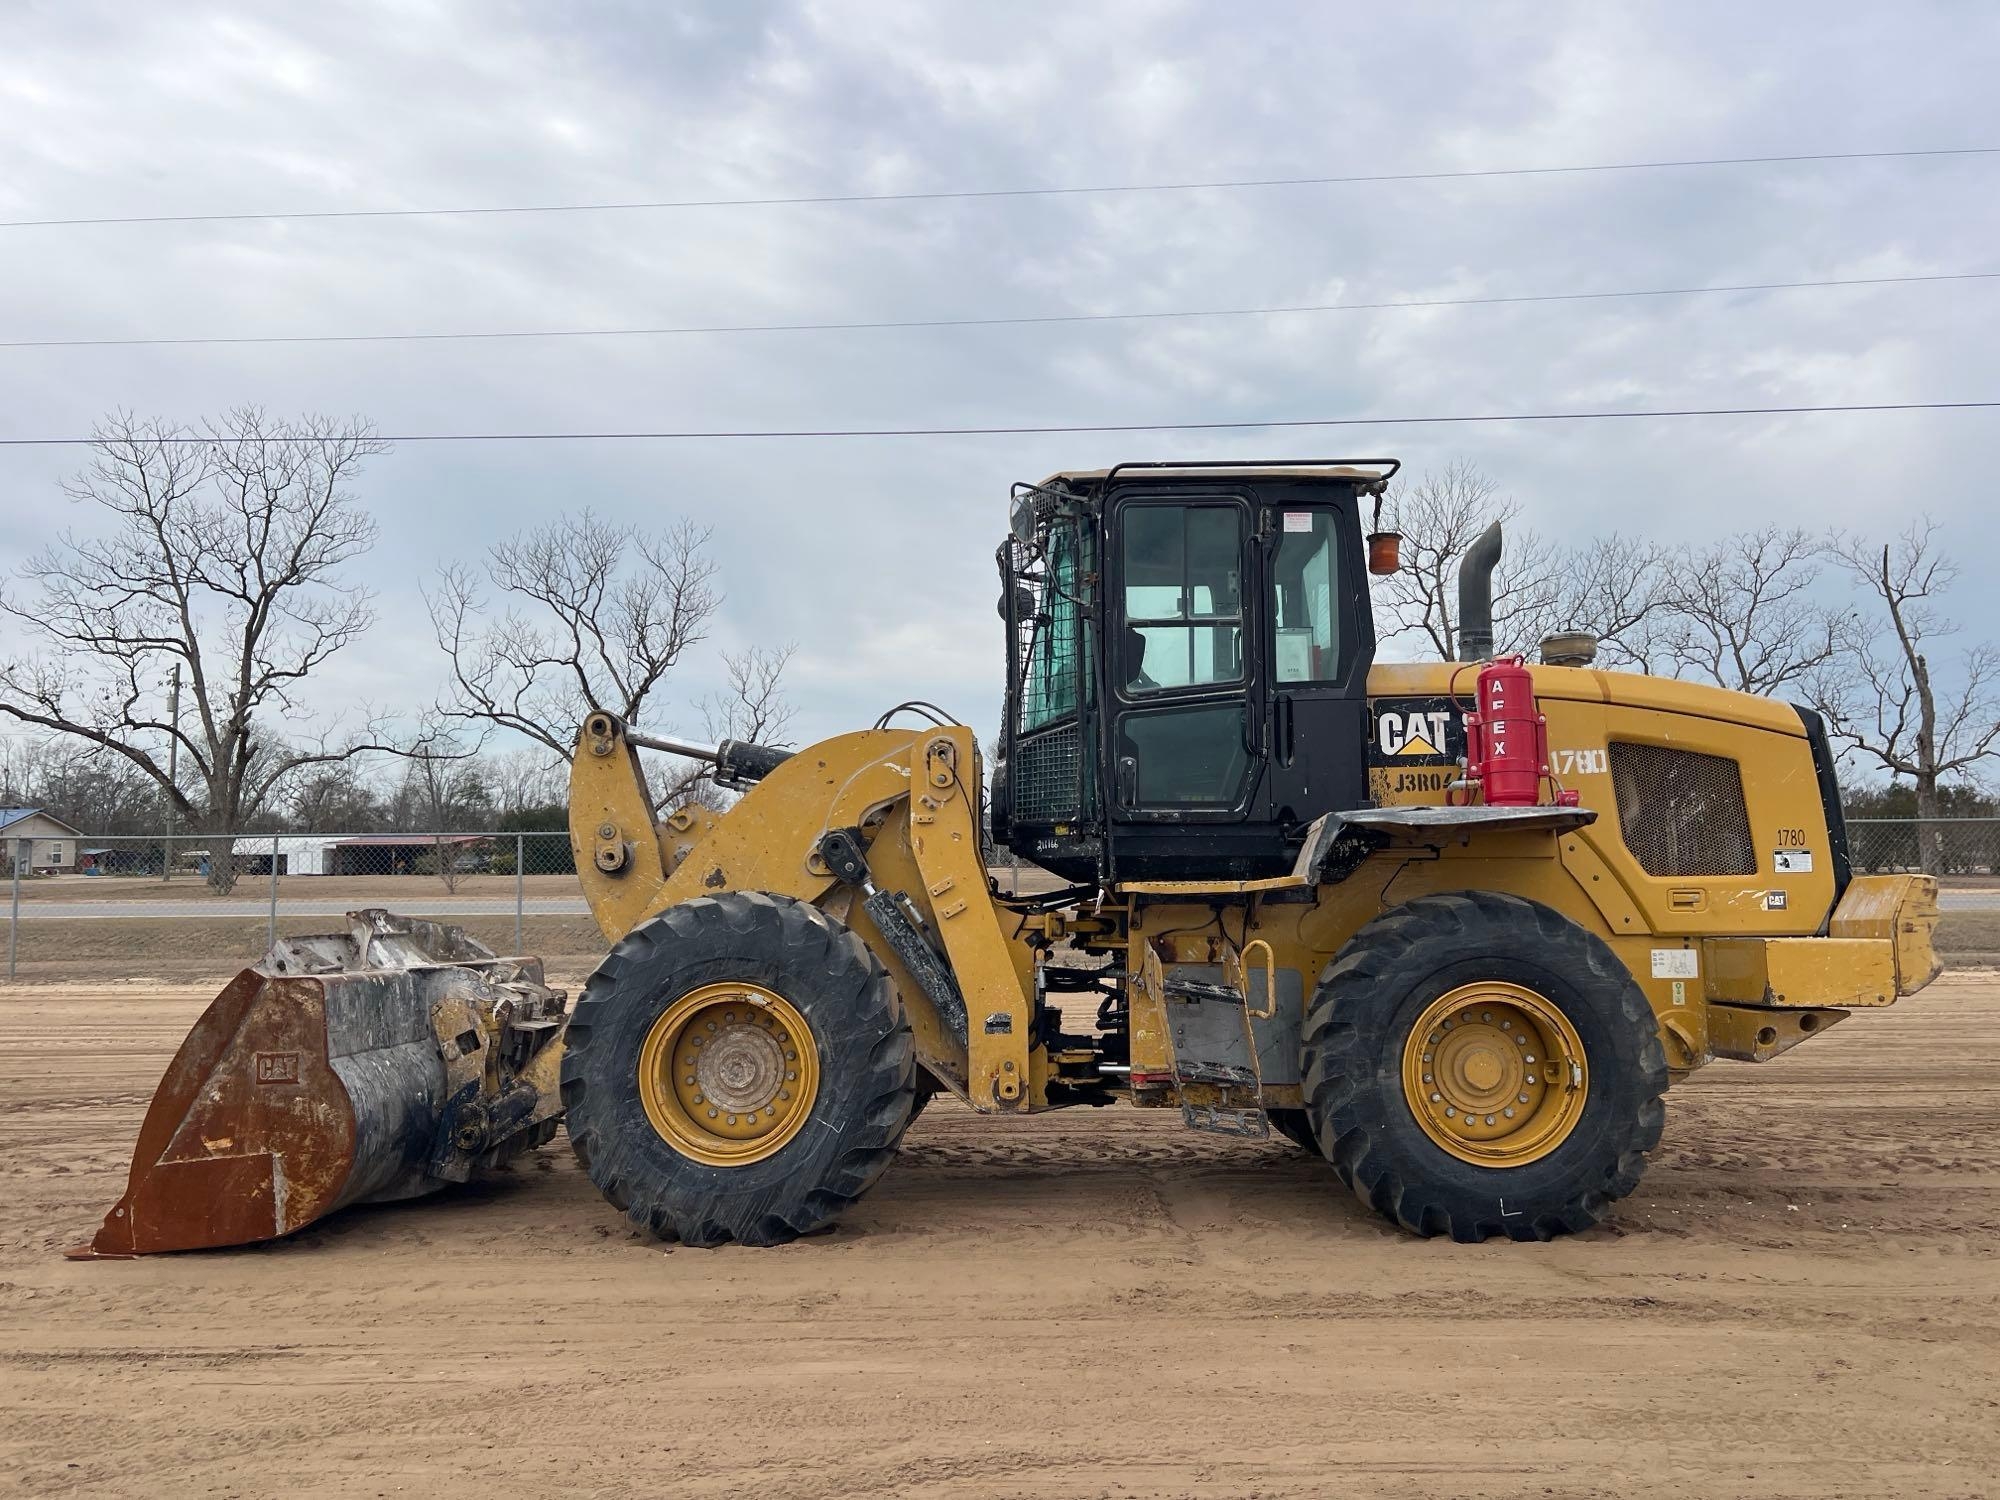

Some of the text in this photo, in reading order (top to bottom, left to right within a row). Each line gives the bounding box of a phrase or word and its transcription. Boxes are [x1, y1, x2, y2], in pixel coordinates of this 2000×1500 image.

[1492, 680, 1505, 755] AFEX
[1379, 711, 1450, 756] CAT
[1777, 829, 1805, 846] 1780
[1768, 895, 1784, 905] CAT
[259, 1057, 297, 1080] CAT
